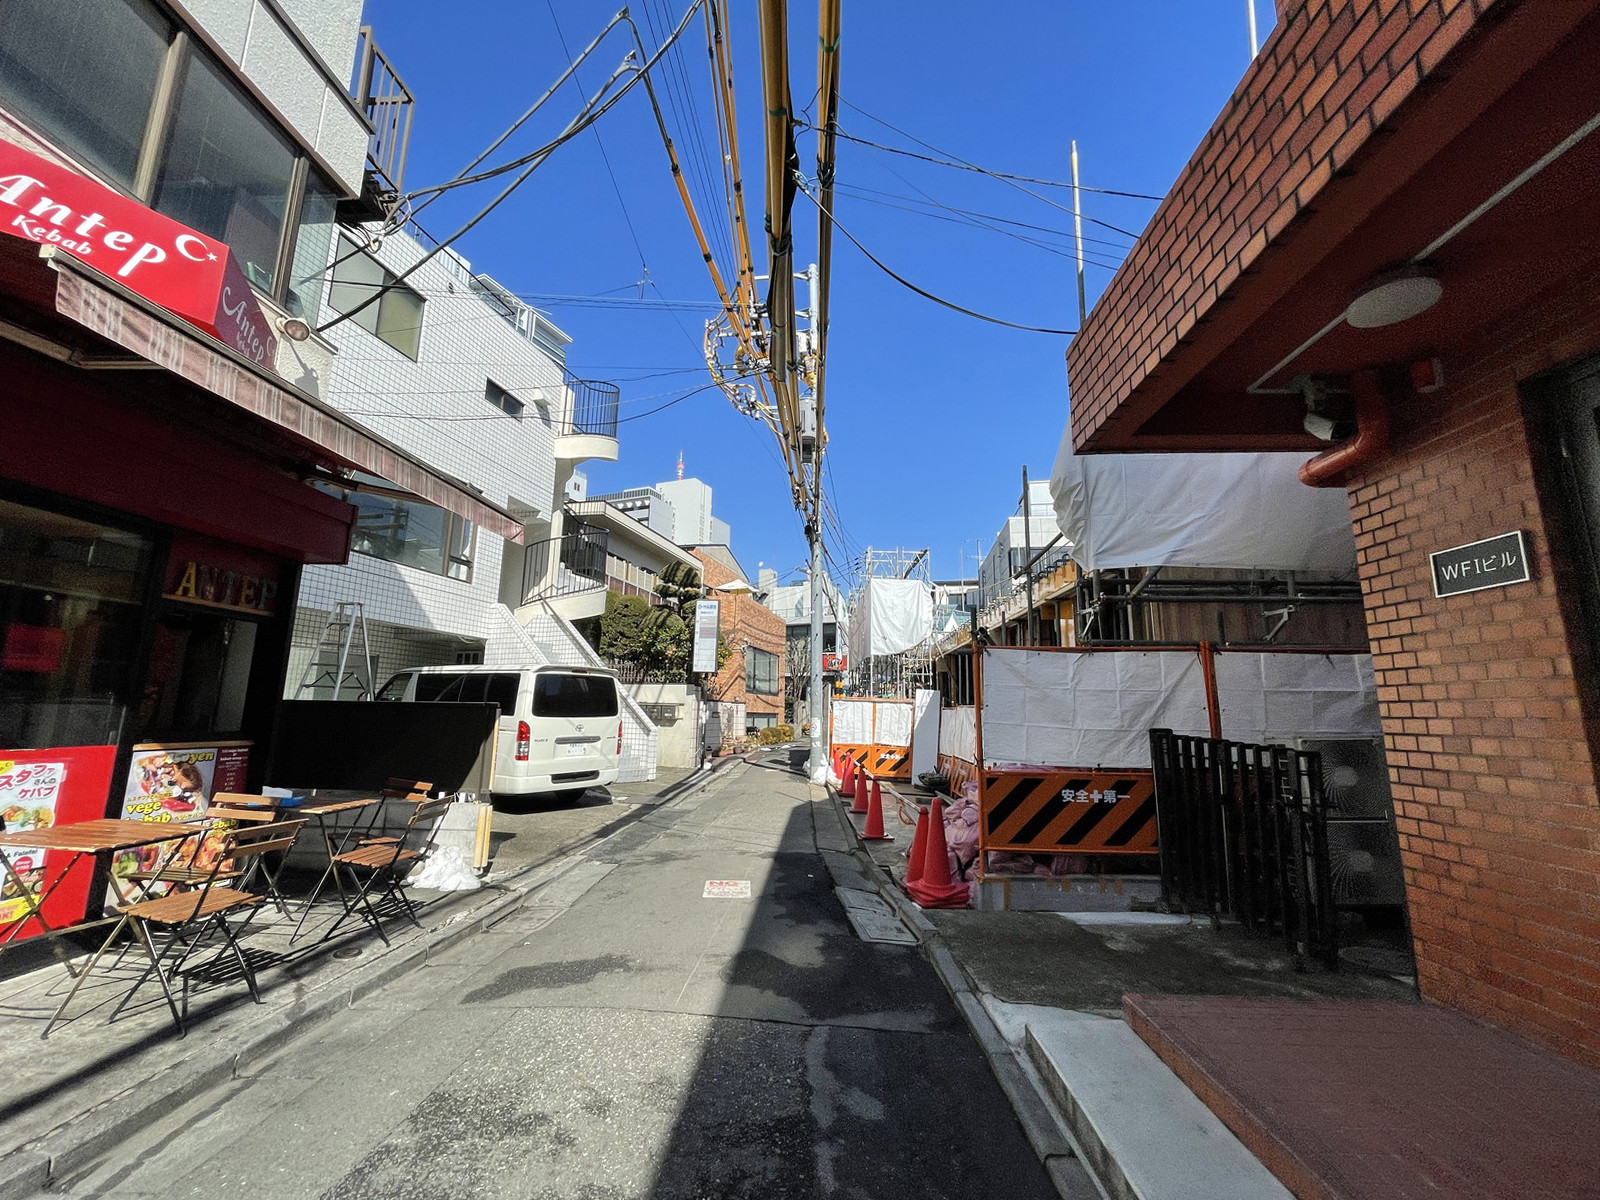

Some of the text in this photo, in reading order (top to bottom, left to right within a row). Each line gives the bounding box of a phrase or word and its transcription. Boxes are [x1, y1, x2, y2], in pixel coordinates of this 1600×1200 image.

[0, 174, 167, 277] Antep
[11, 214, 93, 255] Kebab
[222, 286, 265, 362] Antep
[18, 785, 56, 799] ケバブ
[126, 801, 162, 814] vege
